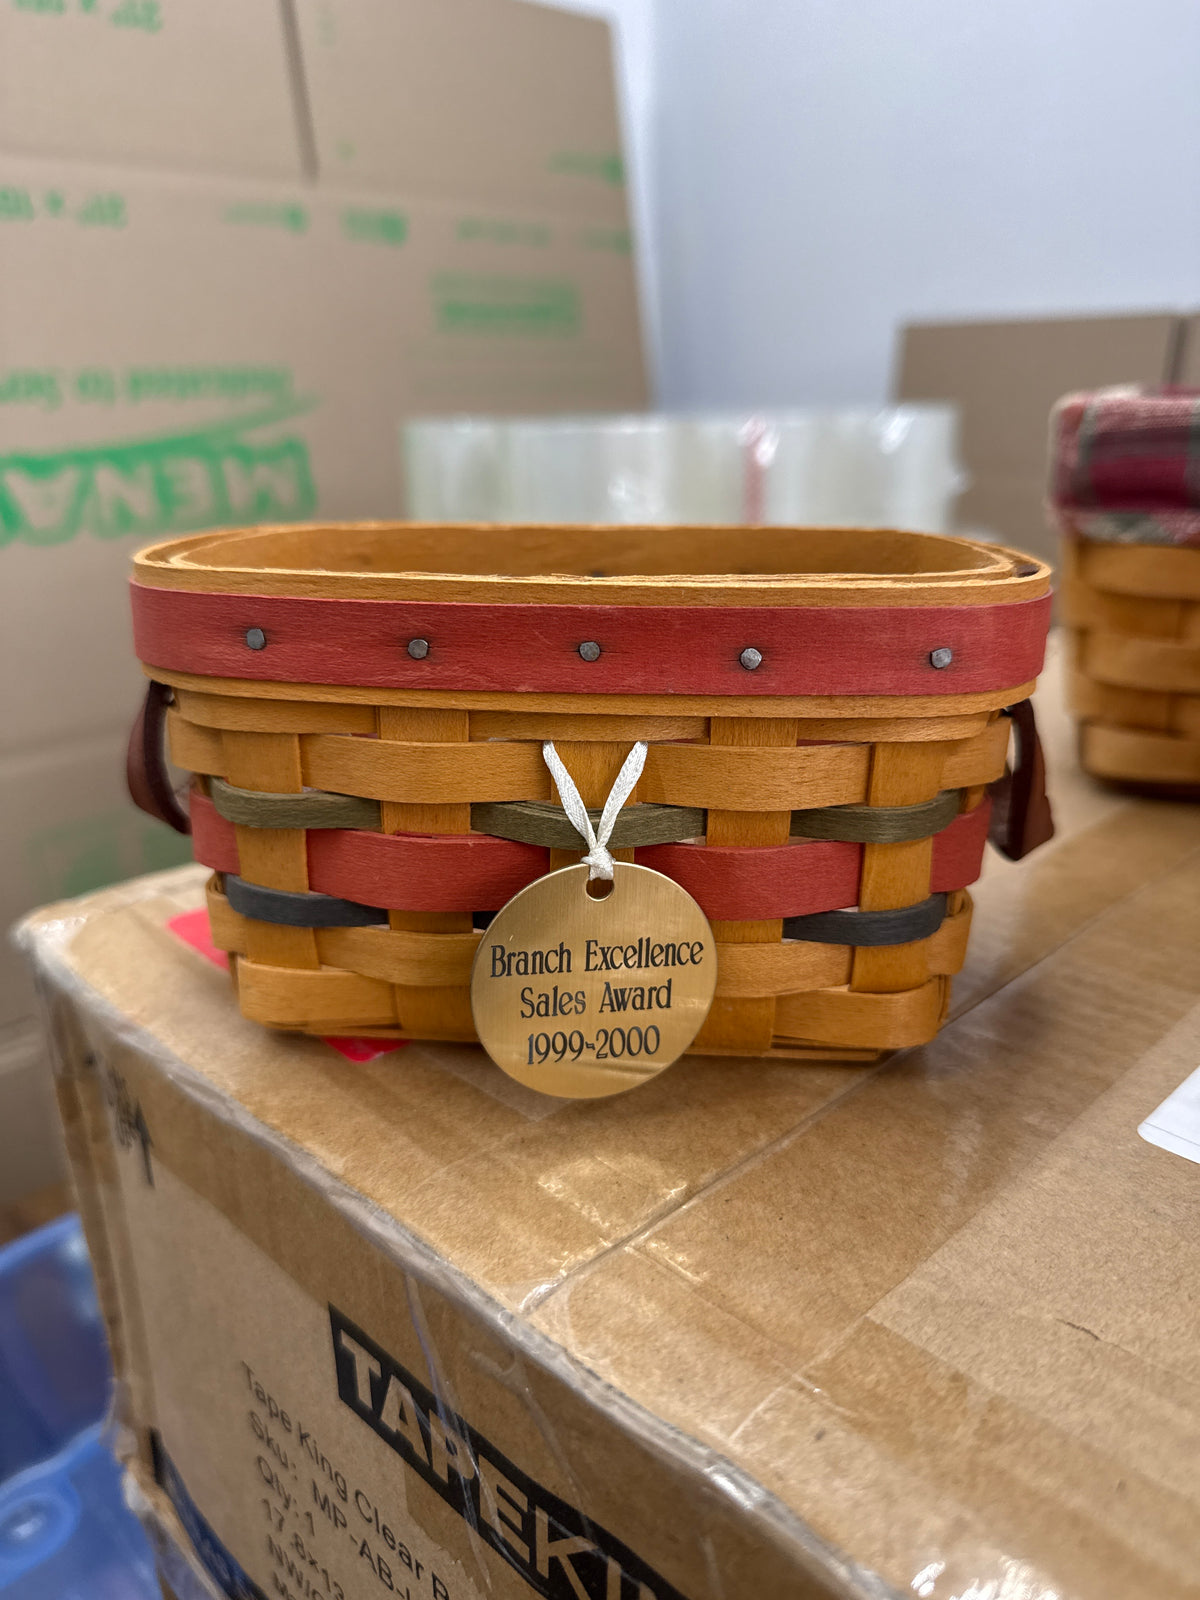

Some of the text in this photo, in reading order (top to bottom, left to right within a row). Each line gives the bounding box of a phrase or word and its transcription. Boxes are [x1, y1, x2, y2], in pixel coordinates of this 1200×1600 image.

[490, 936, 704, 978] Branch Excellence
[520, 977, 673, 1019] Sales Award
[527, 1024, 661, 1066] 1999-2000
[241, 1360, 293, 1434] Tape
[297, 1421, 349, 1503] King
[354, 1488, 425, 1581] Clear
[249, 1408, 299, 1482] Sku:
[339, 1328, 656, 1600] TAPEKI
[256, 1454, 299, 1511] Qty:
